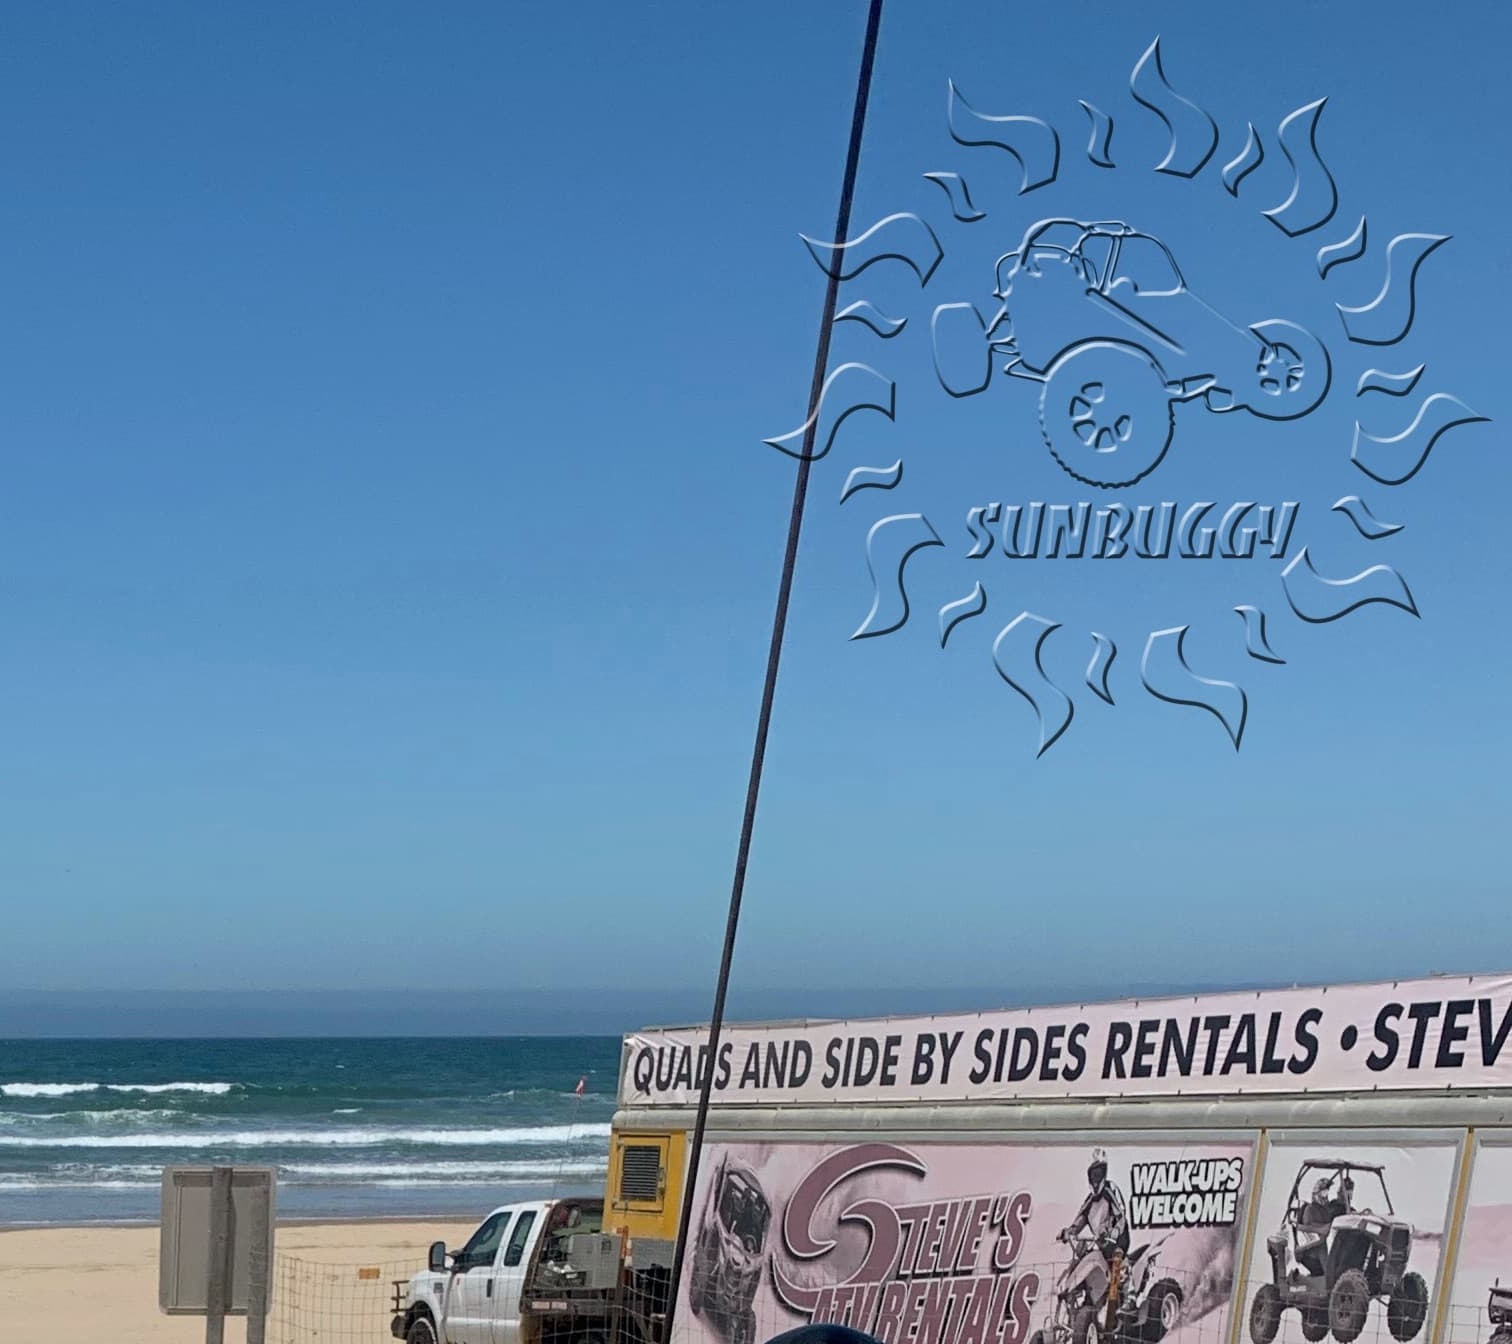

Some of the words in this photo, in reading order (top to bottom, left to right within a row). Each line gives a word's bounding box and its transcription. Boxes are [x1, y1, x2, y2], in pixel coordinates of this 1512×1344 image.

[739, 1040, 812, 1089] AND
[821, 1035, 902, 1088] SIDE
[911, 1031, 964, 1085] BY
[969, 1022, 1090, 1083] SIDES
[1101, 1008, 1324, 1080] RENTALS
[1132, 1158, 1243, 1194] WALK-UPS
[1131, 1192, 1237, 1226] WELCOME
